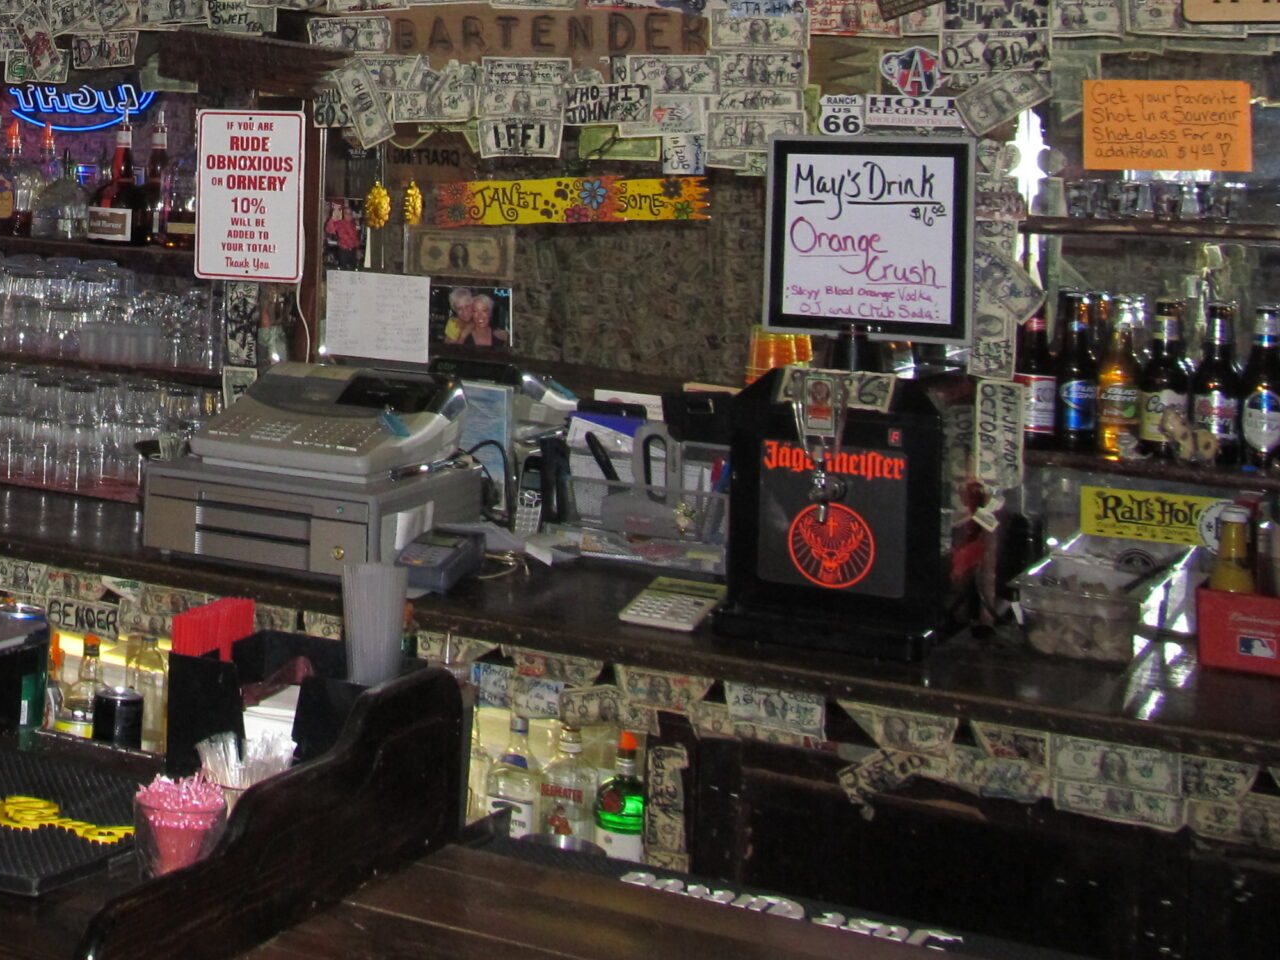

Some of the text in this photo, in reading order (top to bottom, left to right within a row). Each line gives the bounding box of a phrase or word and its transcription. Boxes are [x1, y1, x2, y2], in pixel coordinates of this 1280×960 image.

[394, 12, 709, 54] BARTENDER
[826, 96, 858, 106] RANCH
[1092, 81, 1129, 107] Get
[1134, 91, 1171, 110] your
[831, 106, 852, 115] US
[1091, 106, 1138, 125] Shot
[1159, 112, 1171, 123] a
[1172, 105, 1242, 124] Souvenir
[226, 121, 275, 132] IF YOU ARE
[822, 114, 862, 135] 66
[229, 135, 270, 152] RUDE
[1094, 144, 1170, 160] additional
[205, 154, 294, 172] OBNOXIOUS
[211, 174, 287, 192] OR ORNERY
[794, 161, 936, 221] May's Drink
[231, 197, 266, 215] 10%
[470, 182, 543, 222] JANET
[230, 217, 266, 228] WILL BE
[226, 229, 269, 240] ADDED TO
[221, 241, 276, 254] YOUR TOTAL!
[789, 216, 889, 275] Orange
[225, 256, 270, 272] Thank You
[865, 255, 947, 289] Crush
[825, 286, 854, 296] Blood
[857, 287, 896, 304] Orange
[828, 303, 854, 317] and
